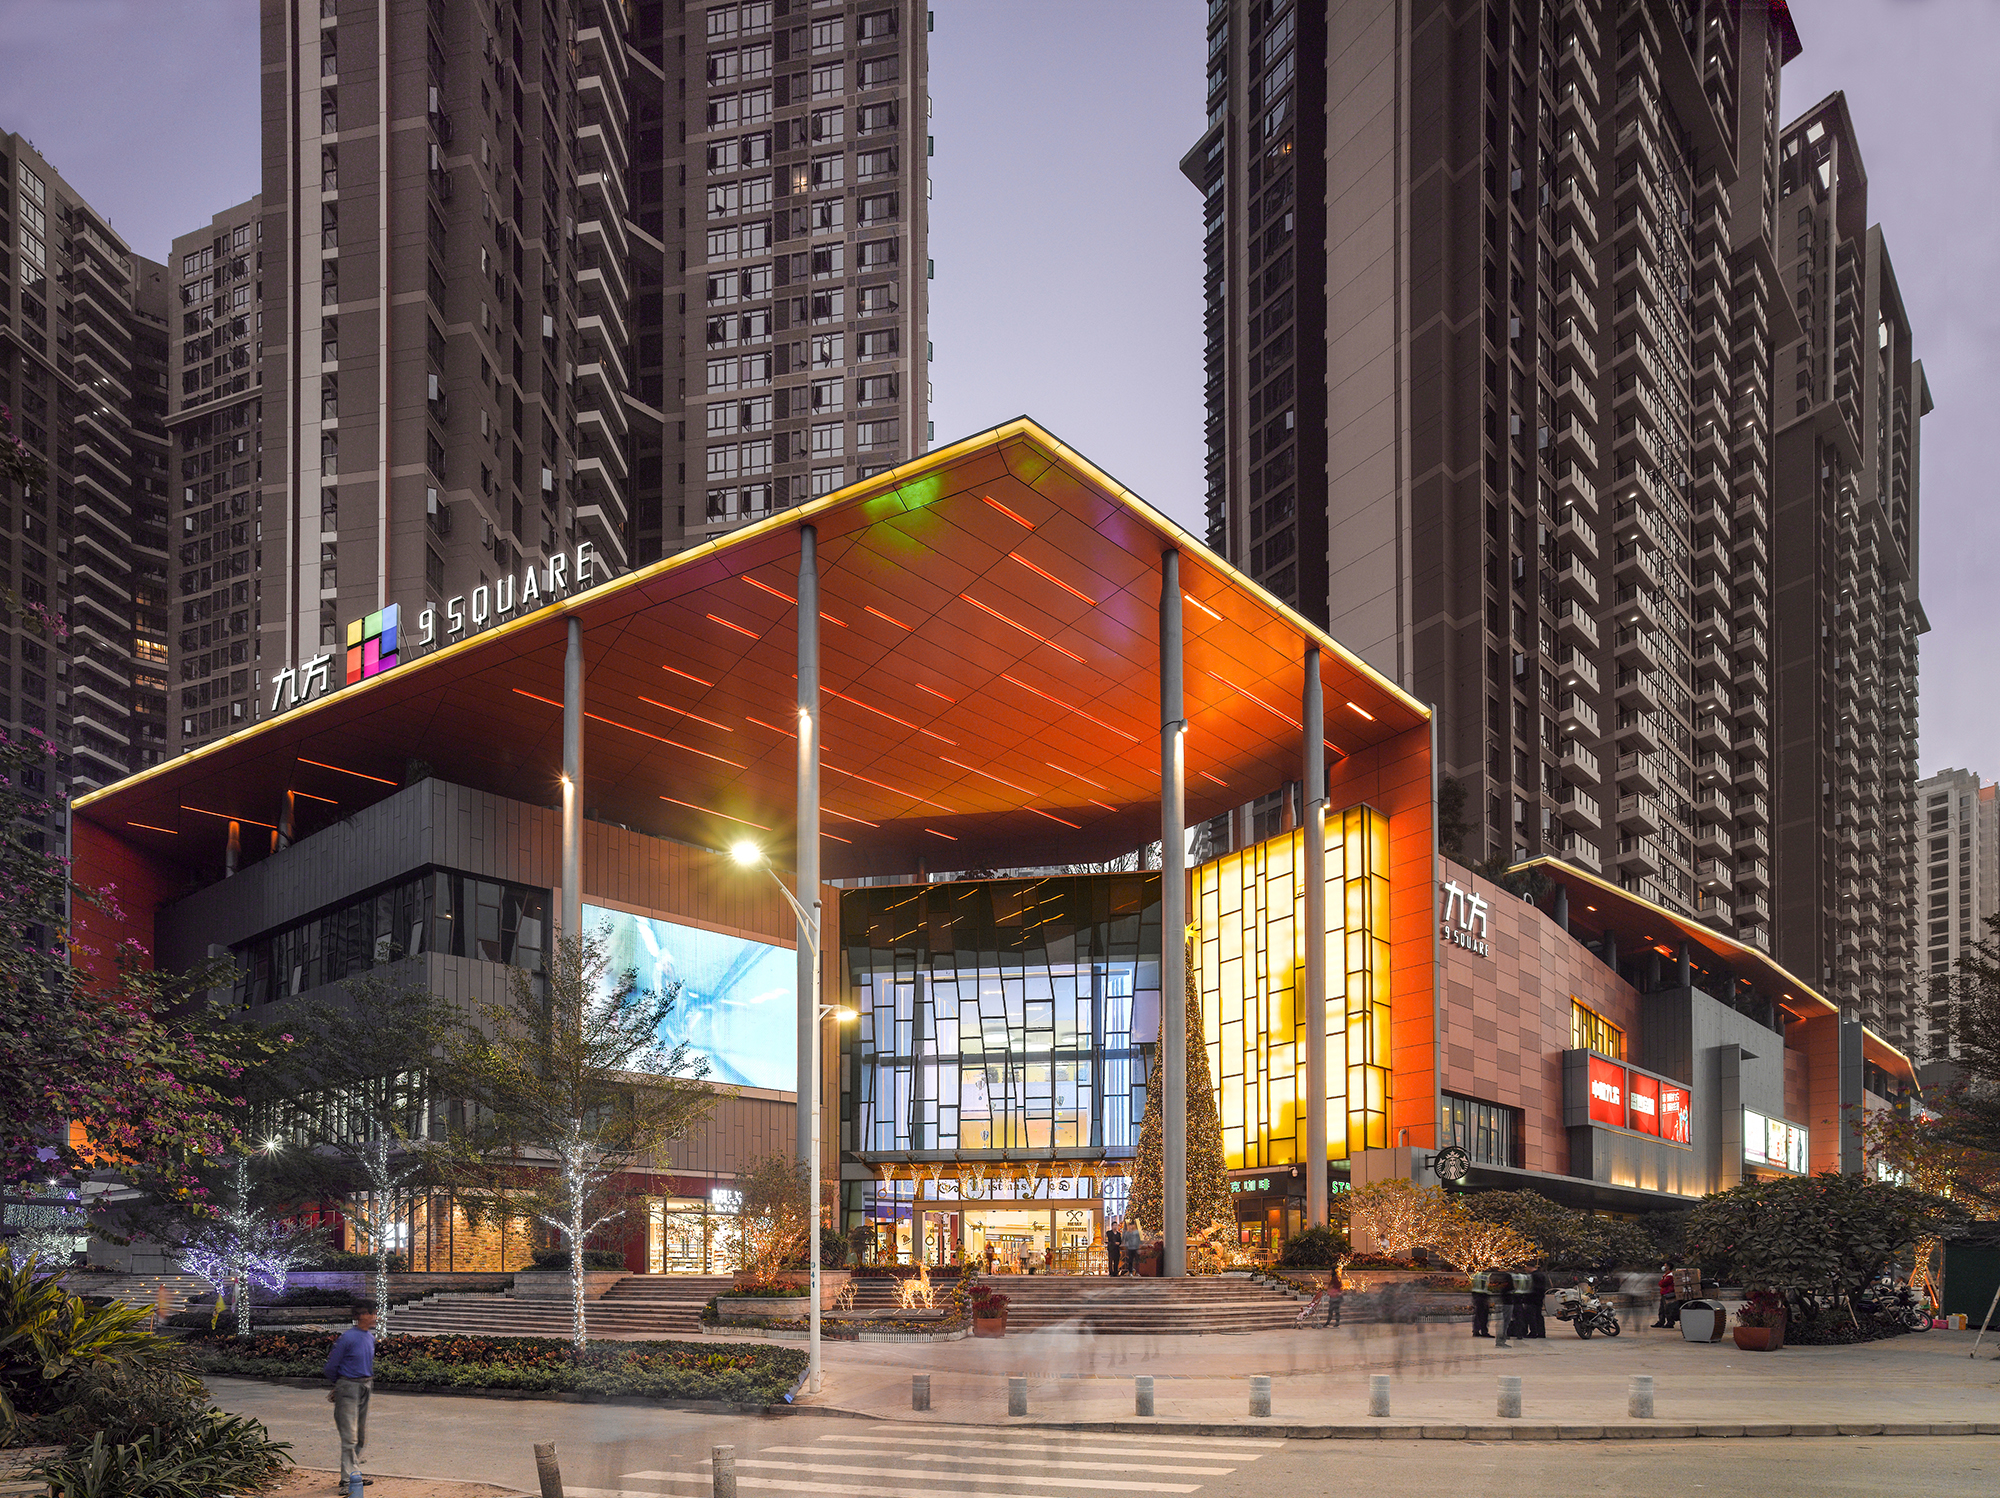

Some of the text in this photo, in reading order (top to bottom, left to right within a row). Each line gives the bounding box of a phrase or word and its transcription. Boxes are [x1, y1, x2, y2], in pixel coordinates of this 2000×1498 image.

[418, 541, 594, 646] 9 SQUARE
[272, 652, 332, 711] 九方
[1444, 880, 1488, 939] 九方
[1453, 929, 1489, 957] SQUARE
